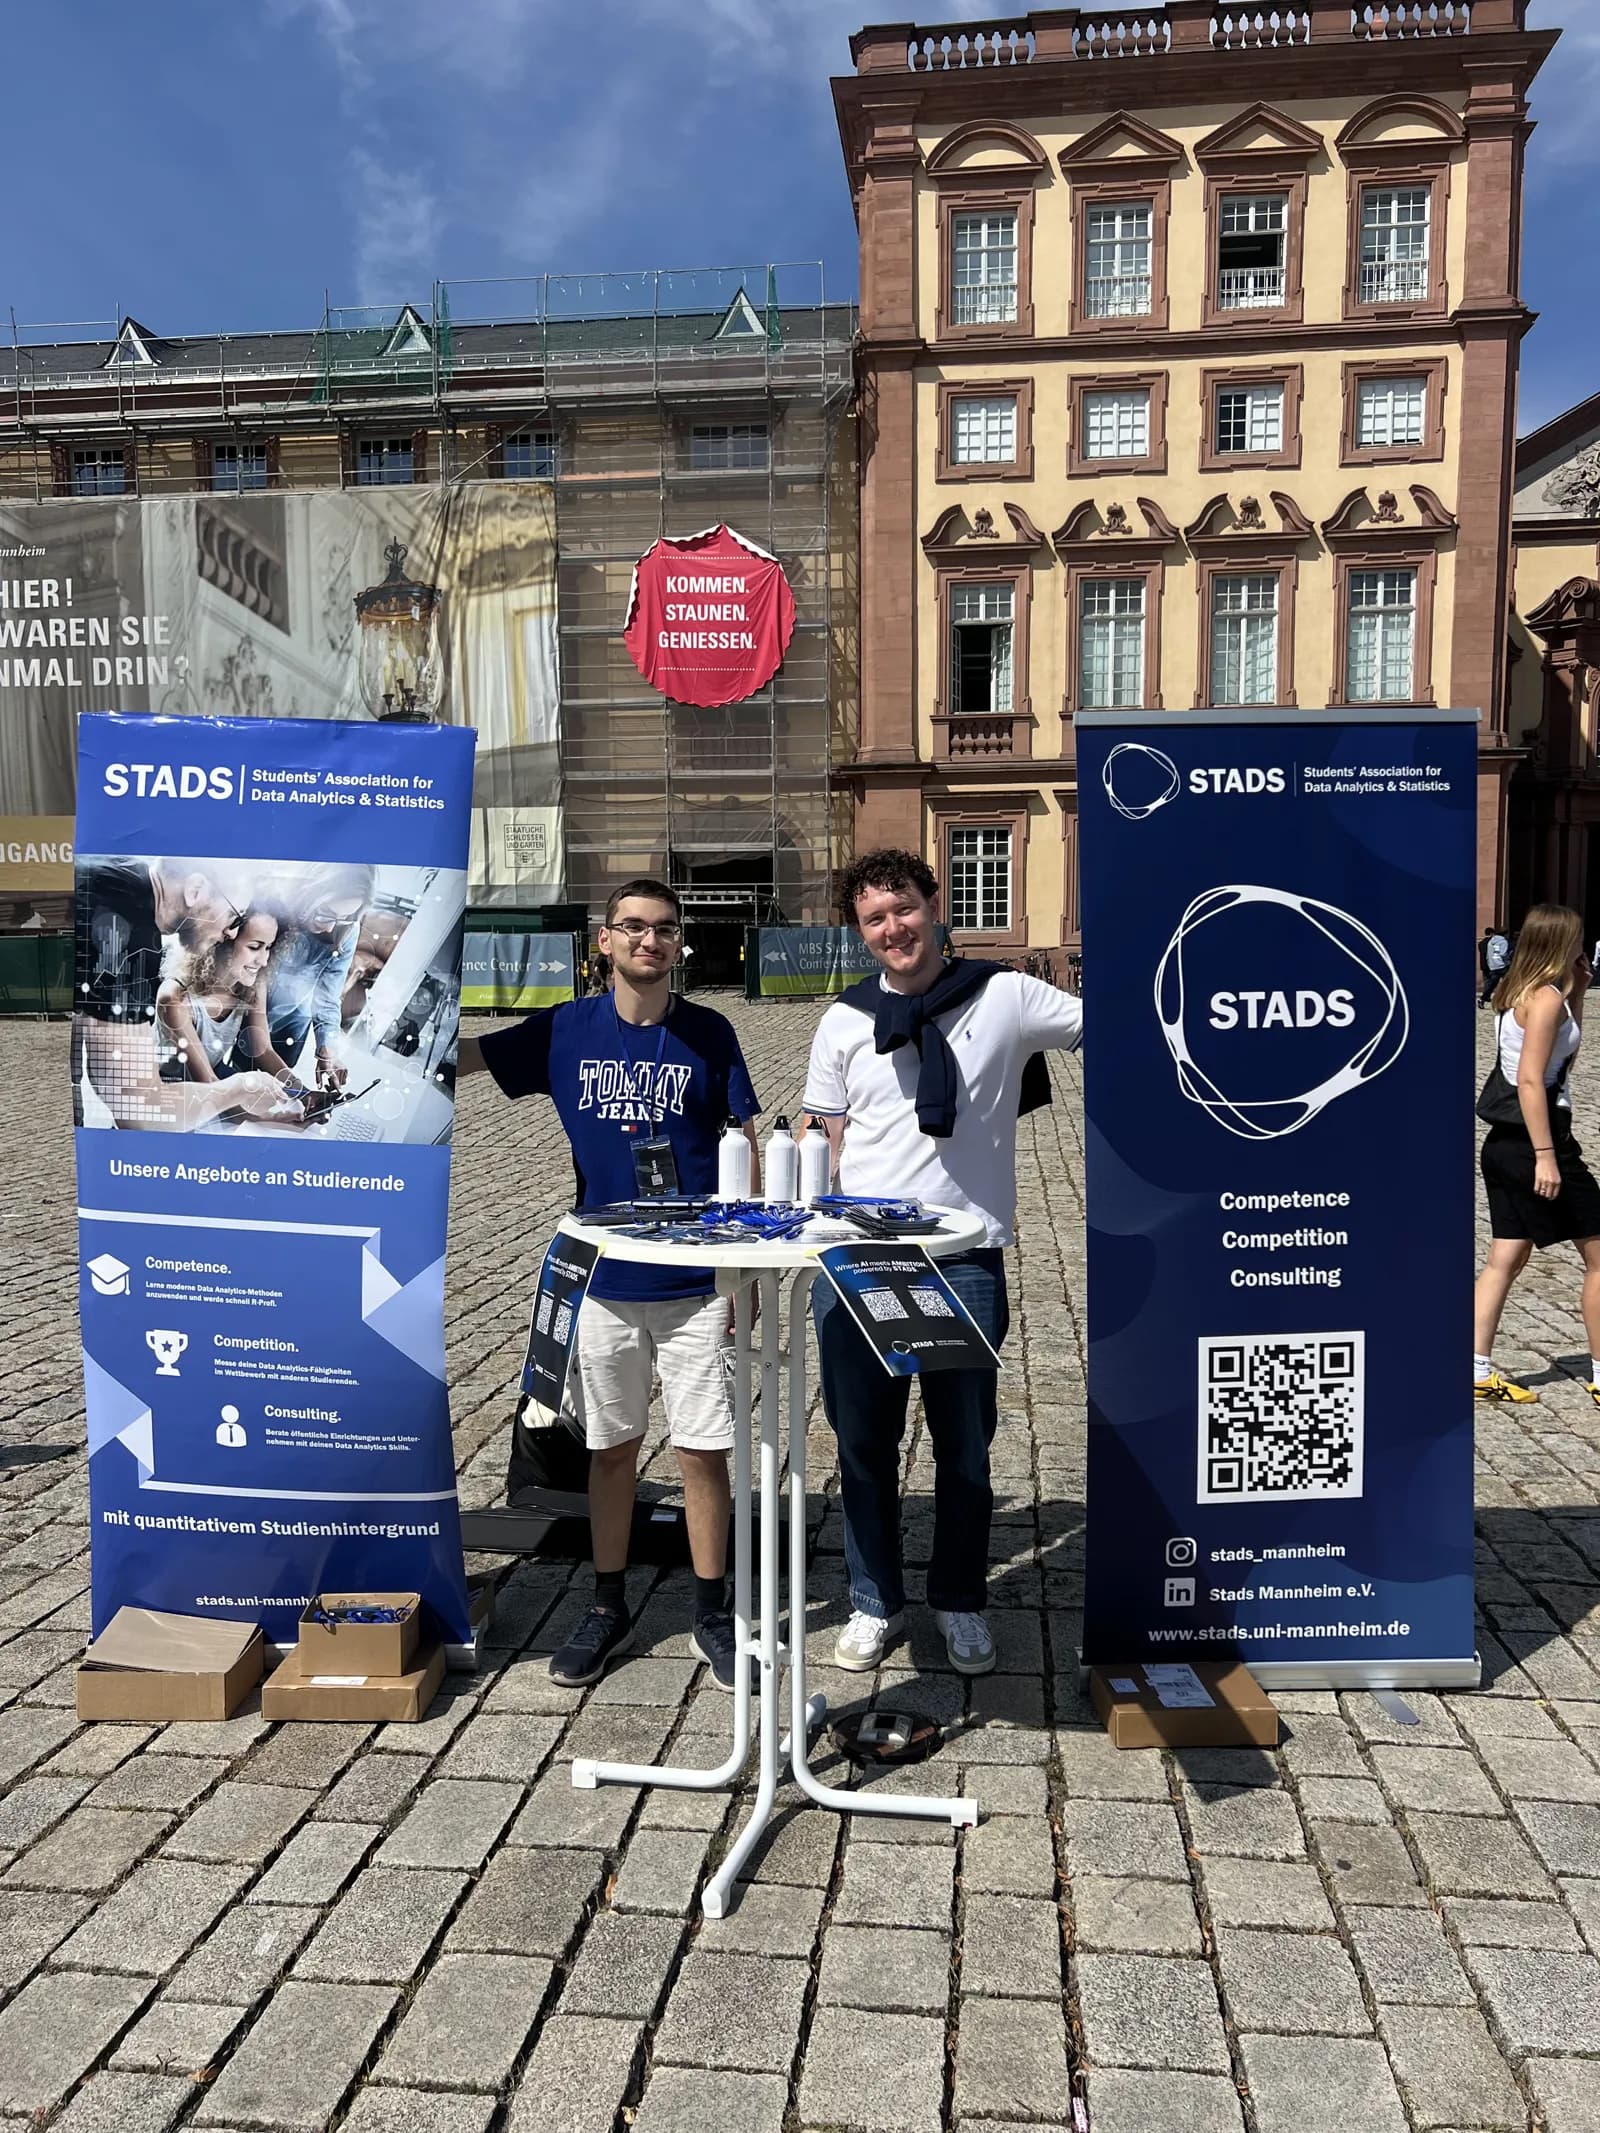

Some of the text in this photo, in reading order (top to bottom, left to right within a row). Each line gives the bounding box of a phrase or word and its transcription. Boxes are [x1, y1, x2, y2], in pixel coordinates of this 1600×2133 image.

[0, 544, 46, 557] nnheim
[666, 576, 750, 593] KOMMEN.
[665, 604, 750, 621] STAUNEN.
[0, 615, 171, 648] WAREN SIE
[658, 631, 757, 649] GENIESSEN.
[92, 655, 189, 687] DRIN?
[324, 772, 409, 788] Association
[413, 776, 433, 789] for
[1189, 768, 1286, 793] STADS
[1359, 766, 1423, 777] Association
[1425, 765, 1442, 776] for
[103, 763, 234, 799] STADS
[1304, 780, 1451, 795] Data Analytics & Statistics
[251, 788, 445, 810] Data Analytics & Statistics
[799, 943, 822, 954] MBS
[825, 942, 855, 955] Sdy
[1208, 989, 1356, 1030] STADS
[578, 1059, 692, 1116] TOMMY
[596, 1102, 665, 1122] JEANS
[110, 1159, 405, 1192] Unsere Angebote an Studierende
[1219, 1190, 1350, 1213] Competence
[1222, 1227, 1349, 1252] Competition
[145, 1256, 232, 1274] Competence.
[1230, 1266, 1343, 1288] Consulting
[146, 1291, 188, 1300] anzuwenden
[166, 1283, 195, 1291] moderne
[197, 1285, 213, 1293] Data
[213, 1334, 300, 1352] Competition.
[238, 1360, 257, 1368] deine
[258, 1362, 275, 1370] Data
[224, 1369, 266, 1379] Wettbewerb
[267, 1372, 279, 1380] mit
[280, 1374, 309, 1382] anderen
[310, 1376, 360, 1386] Studierenden.
[264, 1404, 342, 1424] Consulting.
[265, 1438, 295, 1446] nehmen
[296, 1439, 308, 1448] mit
[309, 1441, 334, 1449] deinen
[335, 1442, 352, 1450] Data
[353, 1443, 387, 1451] Analytics
[103, 1509, 441, 1538] mit quantitativem Studienhintergrund
[1210, 1543, 1346, 1563] stads_mannheim
[195, 1595, 311, 1607] stads.uni-mannh
[1209, 1583, 1376, 1602] Stads Mannheim e.V.
[1148, 1620, 1411, 1642] www.stads.uni-mannheim.de
